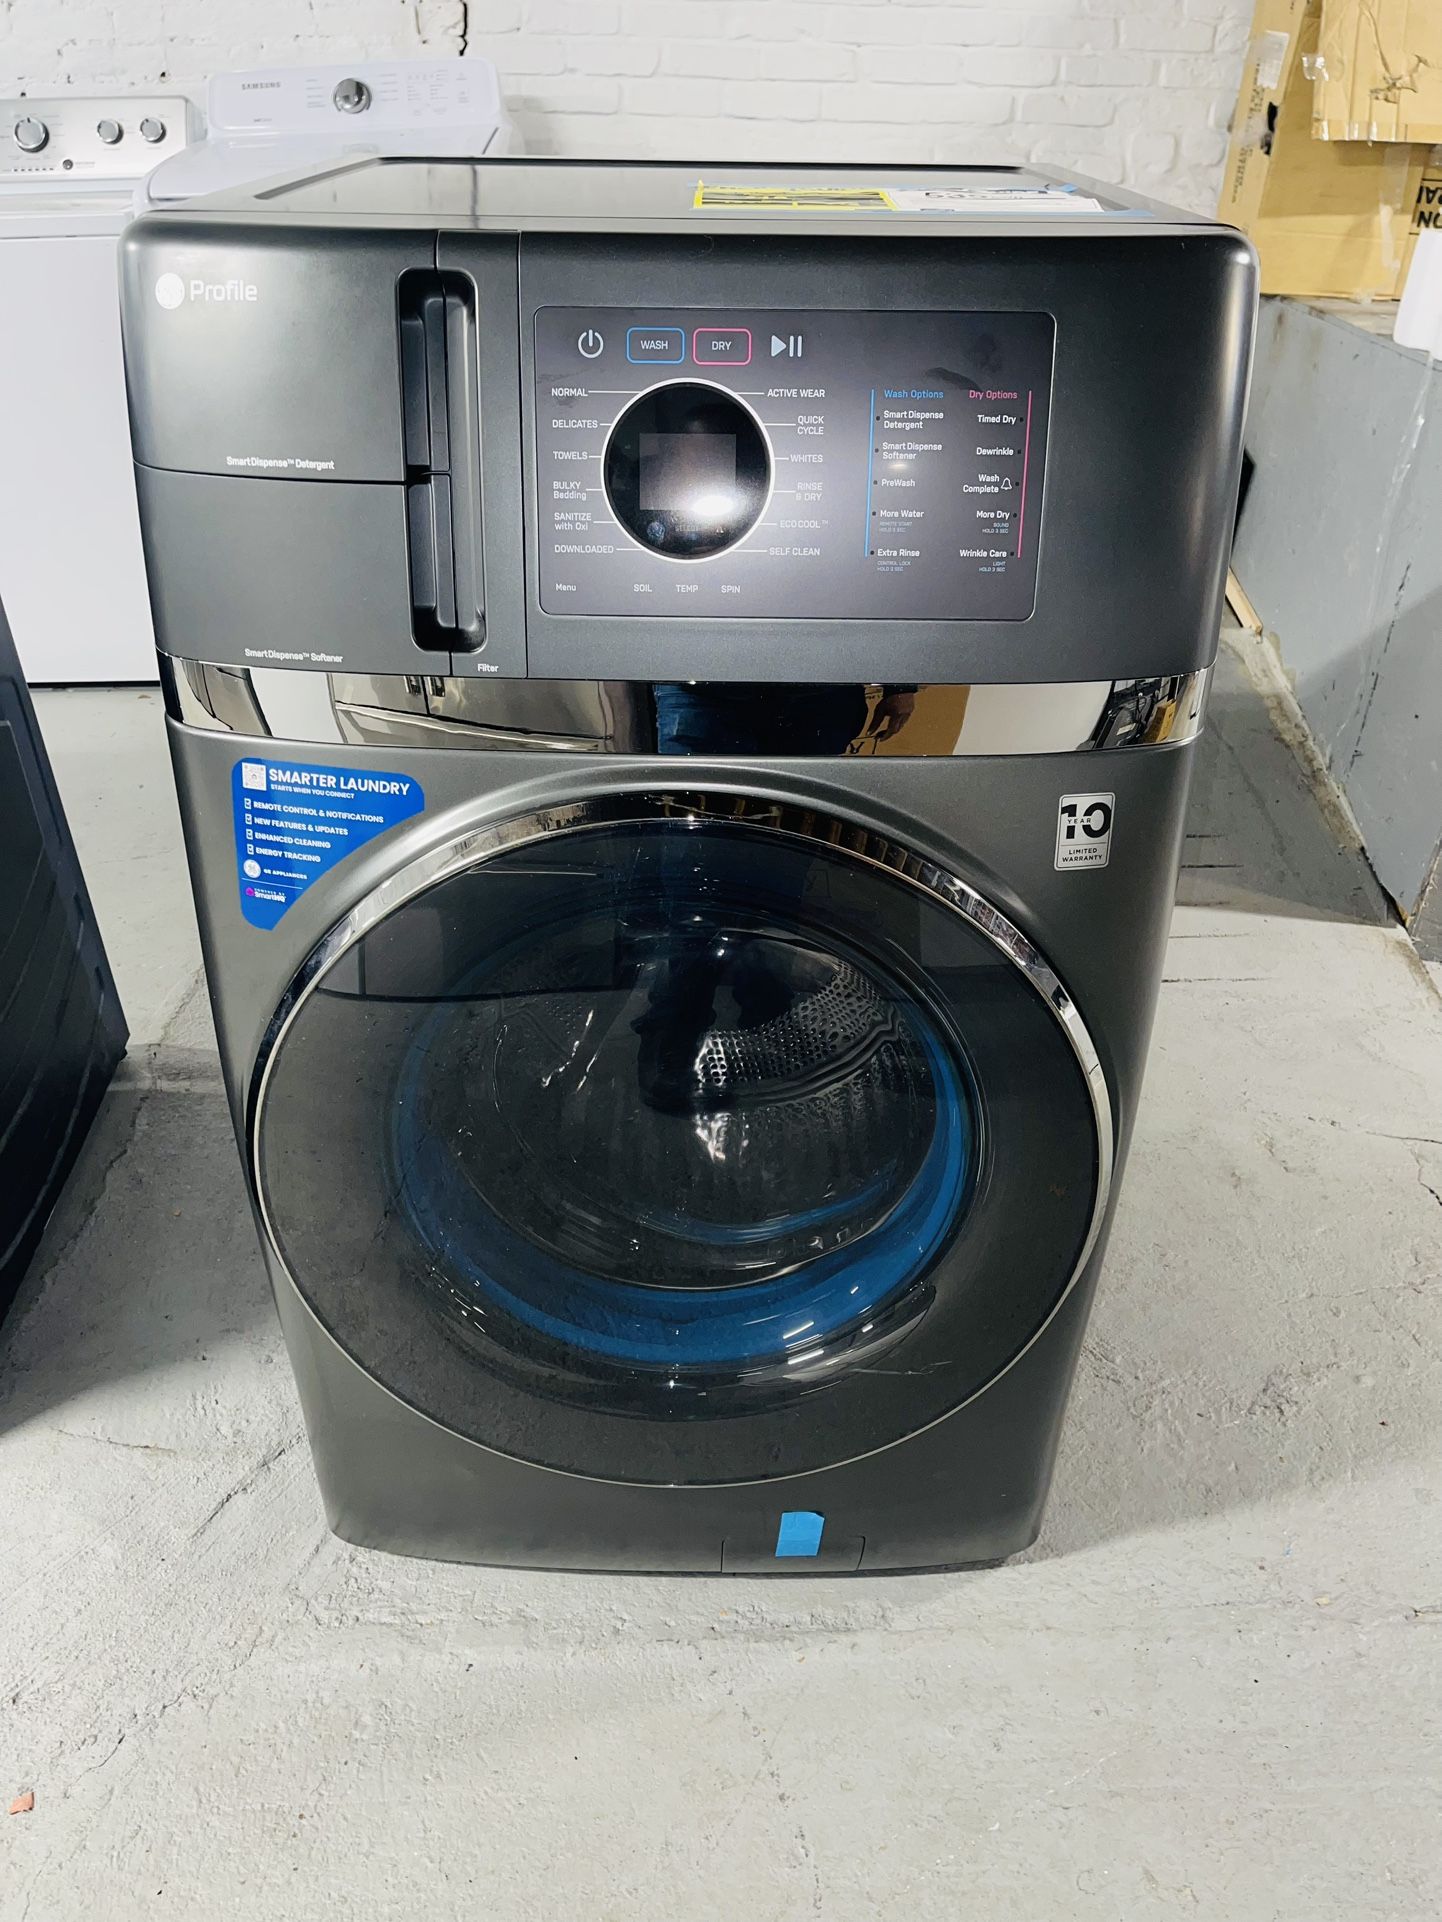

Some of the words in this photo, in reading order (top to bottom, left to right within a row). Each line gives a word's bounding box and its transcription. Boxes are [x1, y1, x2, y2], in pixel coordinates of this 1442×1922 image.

[190, 280, 258, 301] Profile
[640, 340, 669, 350] WASH
[711, 341, 732, 350] DRY
[552, 388, 588, 396] NORMAL
[767, 388, 798, 397] ACTIVE
[800, 389, 826, 398] WEAR
[884, 390, 908, 398] Wash
[910, 390, 944, 400] Options
[969, 390, 984, 400] Dry
[986, 390, 1018, 400] Options
[552, 420, 598, 428] DELICATES
[797, 415, 824, 424] QUICK
[977, 414, 1001, 423] Timed
[1002, 415, 1016, 425] Dry
[884, 420, 924, 430] Detergent
[797, 426, 824, 435] CYCLE
[553, 451, 588, 460] TOWELS
[883, 451, 917, 460] Softener
[976, 447, 1014, 456] Dewrinkle
[790, 454, 823, 463] WHITES
[296, 459, 335, 471] Detergent
[978, 474, 999, 482] Wash
[553, 481, 581, 490] BULKY
[797, 482, 823, 491] RINSE
[881, 479, 915, 487] PreWash
[963, 484, 999, 494] Complete
[553, 491, 587, 501] Bedding
[804, 493, 822, 501] DRY
[554, 512, 592, 521] SANITIZE
[880, 510, 899, 518] More
[900, 510, 924, 518] Water
[976, 510, 995, 518] More
[996, 510, 1010, 520] Dry
[554, 522, 573, 530] with
[575, 522, 588, 530] Oxi
[554, 545, 614, 553] DOWNLOADED
[770, 547, 790, 556] SELF
[792, 548, 821, 556] CLEAN
[877, 548, 897, 557] Extra
[899, 549, 920, 557] Rinse
[960, 549, 988, 557] Wrinkle
[989, 550, 1007, 558] Care
[555, 583, 577, 591] Menu
[633, 584, 652, 592] SOIL
[676, 584, 699, 593] TEMP
[721, 585, 741, 594] SPIN
[311, 653, 343, 663] Softener
[478, 663, 499, 673] Filter
[269, 768, 337, 788] SMARTER
[340, 776, 410, 796] LAUNDRY
[271, 784, 293, 793] STARTS
[293, 787, 311, 795] WHEN
[325, 790, 355, 799] CONNECT
[253, 801, 282, 812] REMOTE
[283, 805, 318, 817] CONTROL
[319, 809, 325, 817] &
[326, 810, 384, 823] NOTIFICATIONS
[1061, 802, 1112, 839] 10
[254, 817, 270, 826] NEW
[271, 820, 307, 831] FEATURES
[314, 825, 348, 836] UPDATES
[255, 832, 293, 844] ENHANCED
[294, 838, 331, 849] CLEANING
[255, 847, 283, 858] ENERGY
[284, 851, 321, 863] TRACKING
